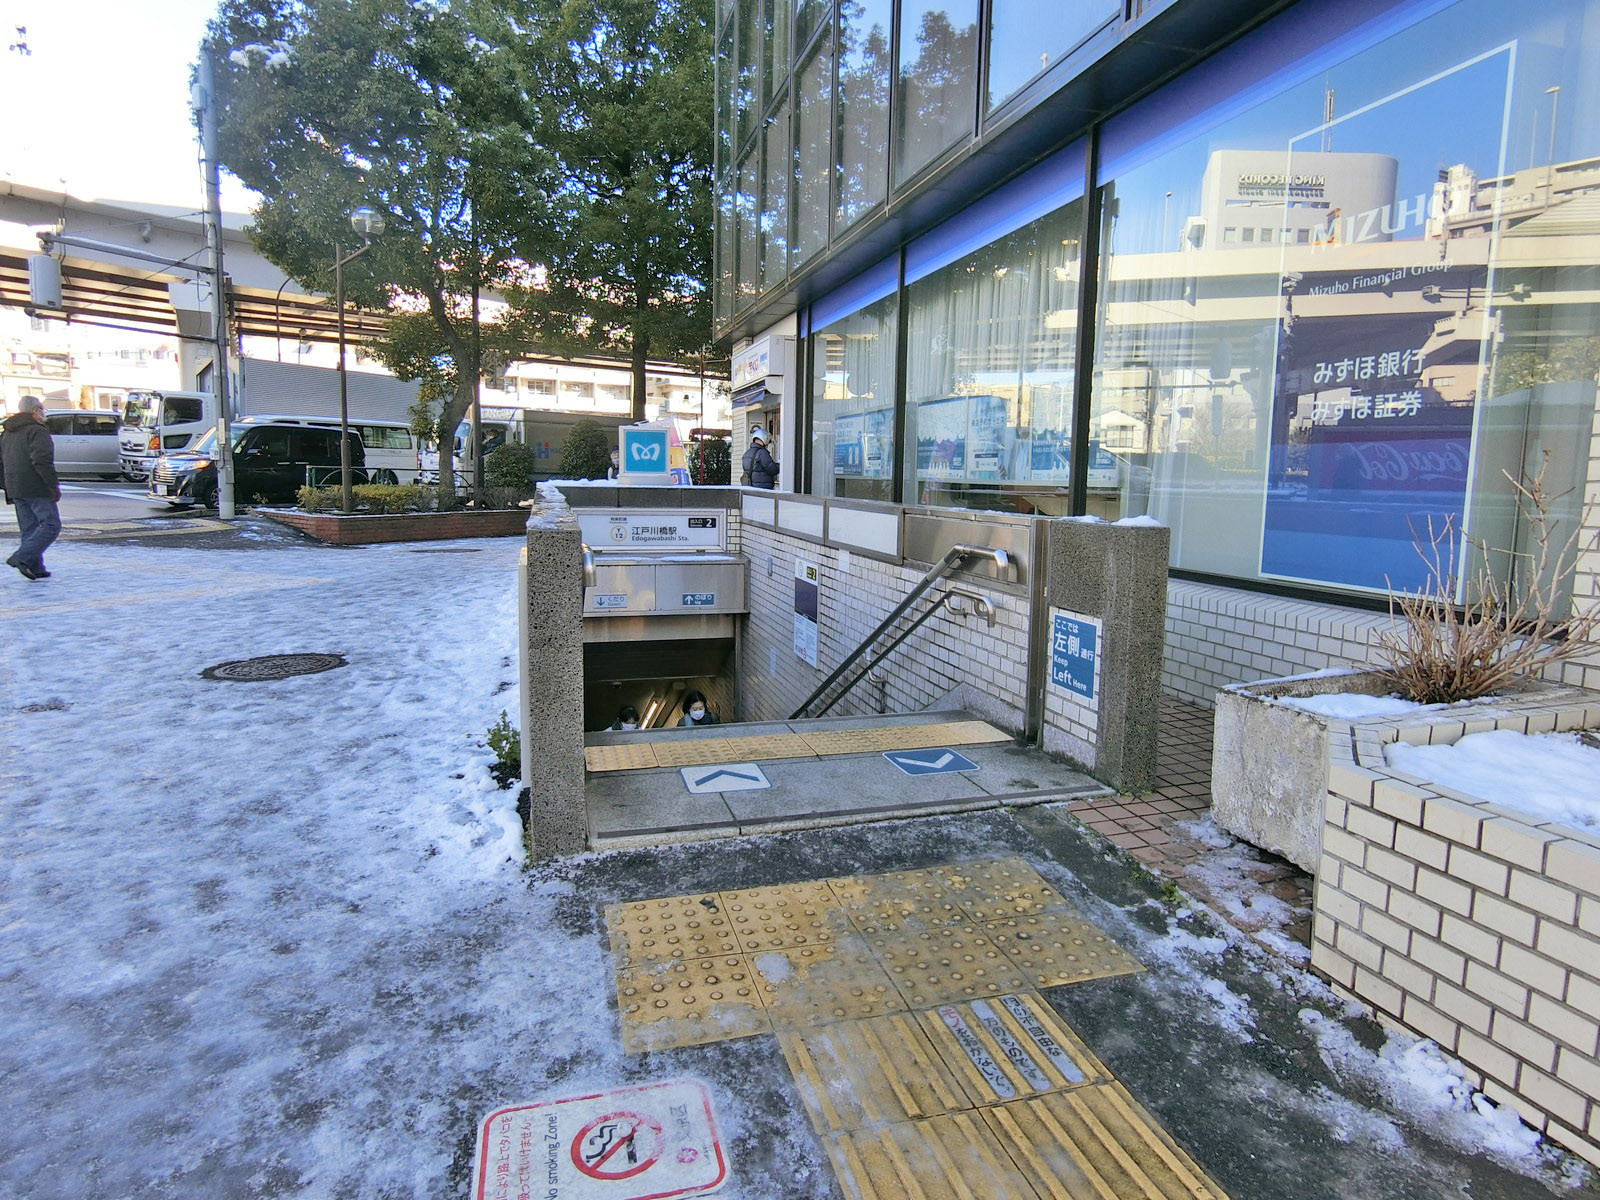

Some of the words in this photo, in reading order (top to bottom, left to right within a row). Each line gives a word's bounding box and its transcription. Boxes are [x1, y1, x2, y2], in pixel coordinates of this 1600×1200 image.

[1309, 280, 1349, 297] Mizuho
[1352, 266, 1406, 289] Financial
[1411, 258, 1454, 275] Group
[1313, 348, 1426, 383] みずほ銀行
[1310, 390, 1422, 421] みずほ証券
[632, 526, 677, 536] 江戸川橋駅
[706, 518, 712, 528] 2
[1056, 619, 1078, 634] ここでは
[1054, 632, 1094, 662] 左側通行
[1054, 654, 1069, 667] Keep
[1054, 667, 1072, 686] Left
[1072, 679, 1087, 692] Here
[544, 1112, 558, 1141] Zone!
[495, 1116, 512, 1200] により路上でタバコを
[544, 1141, 560, 1184] smoking
